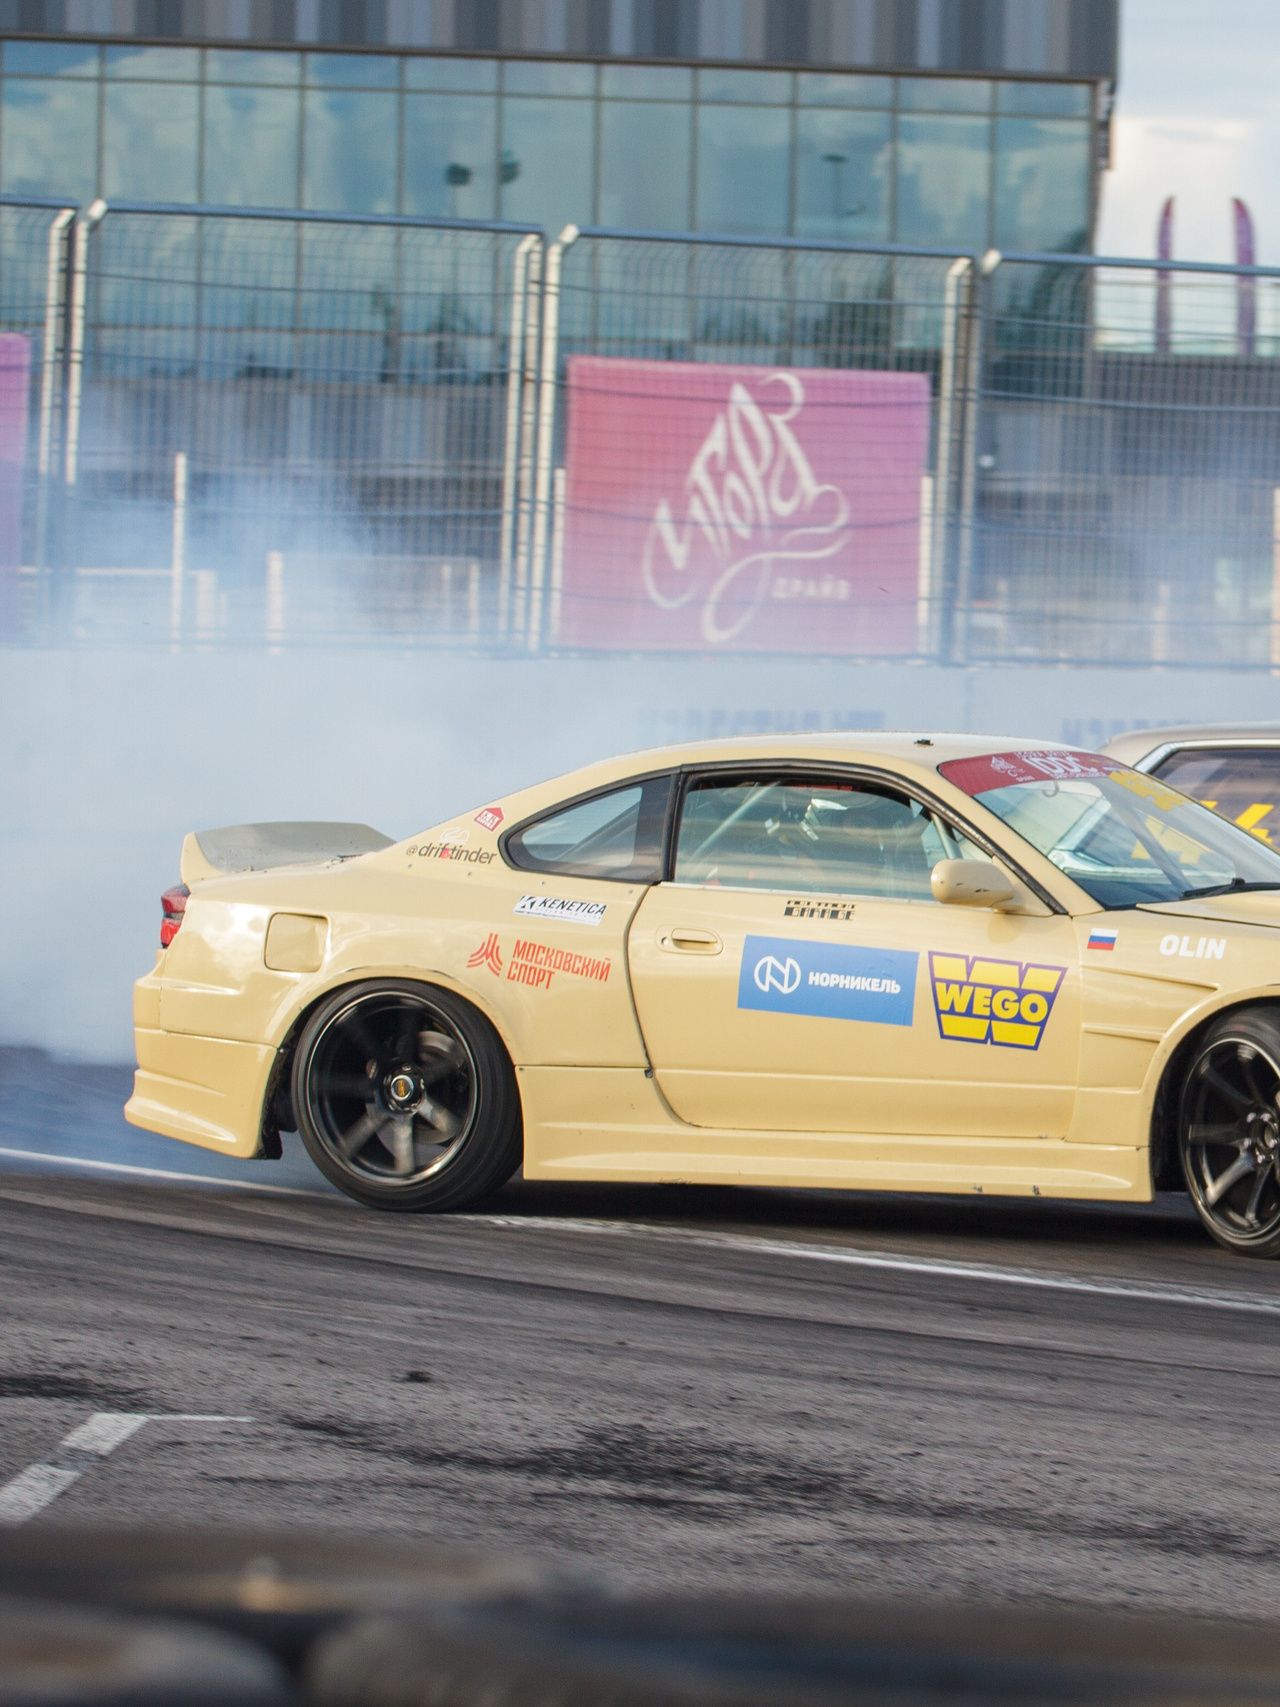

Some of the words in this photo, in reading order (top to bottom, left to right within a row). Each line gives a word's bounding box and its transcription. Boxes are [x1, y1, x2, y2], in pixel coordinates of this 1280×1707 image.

[538, 897, 608, 916] KENETICA
[512, 939, 611, 982] МОСКОВСКИЙ
[1159, 934, 1227, 960] OLIN
[507, 961, 555, 990] СПОРТ
[808, 971, 901, 994] НОРНИКЕЛЬ
[935, 981, 1048, 1023] WEGO
